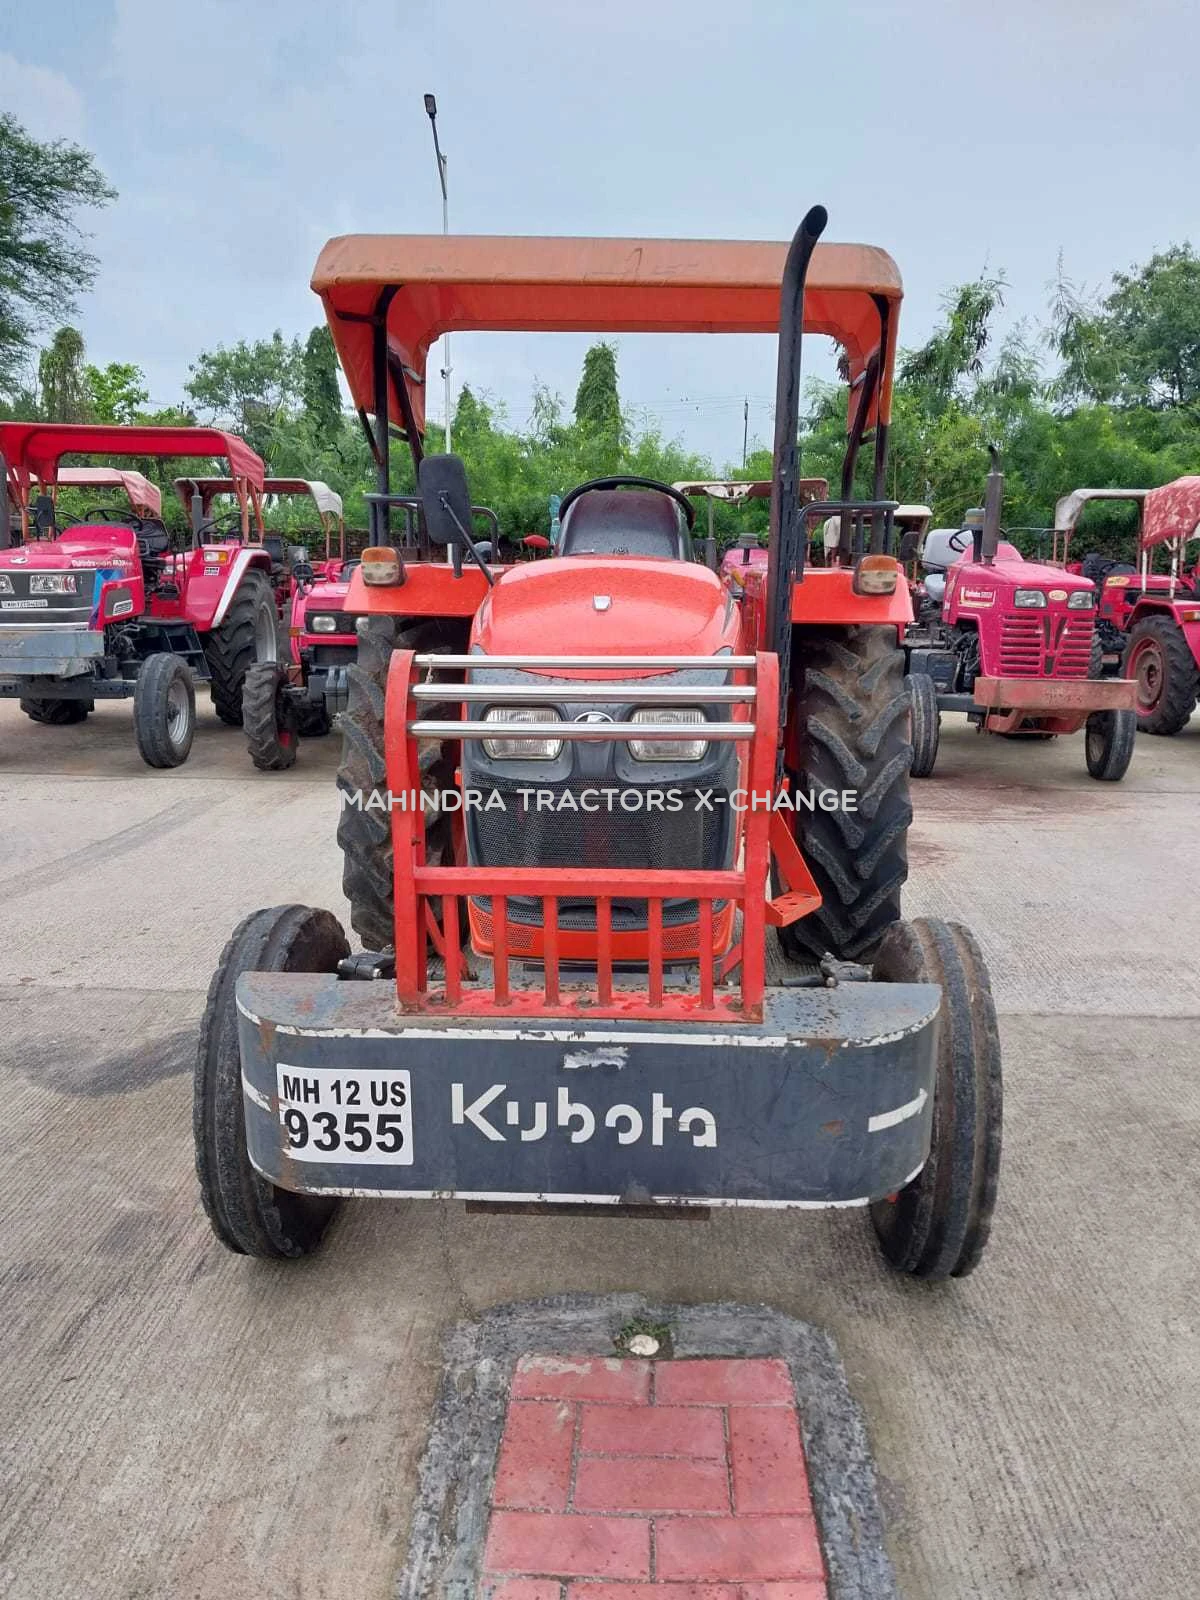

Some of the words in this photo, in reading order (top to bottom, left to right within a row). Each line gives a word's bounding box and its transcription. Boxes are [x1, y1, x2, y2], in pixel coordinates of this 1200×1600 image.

[282, 1074, 320, 1104] MH
[330, 1079, 361, 1106] 12
[370, 1080, 407, 1107] US
[284, 1108, 404, 1153] 9355
[451, 1083, 718, 1148] Kubota
